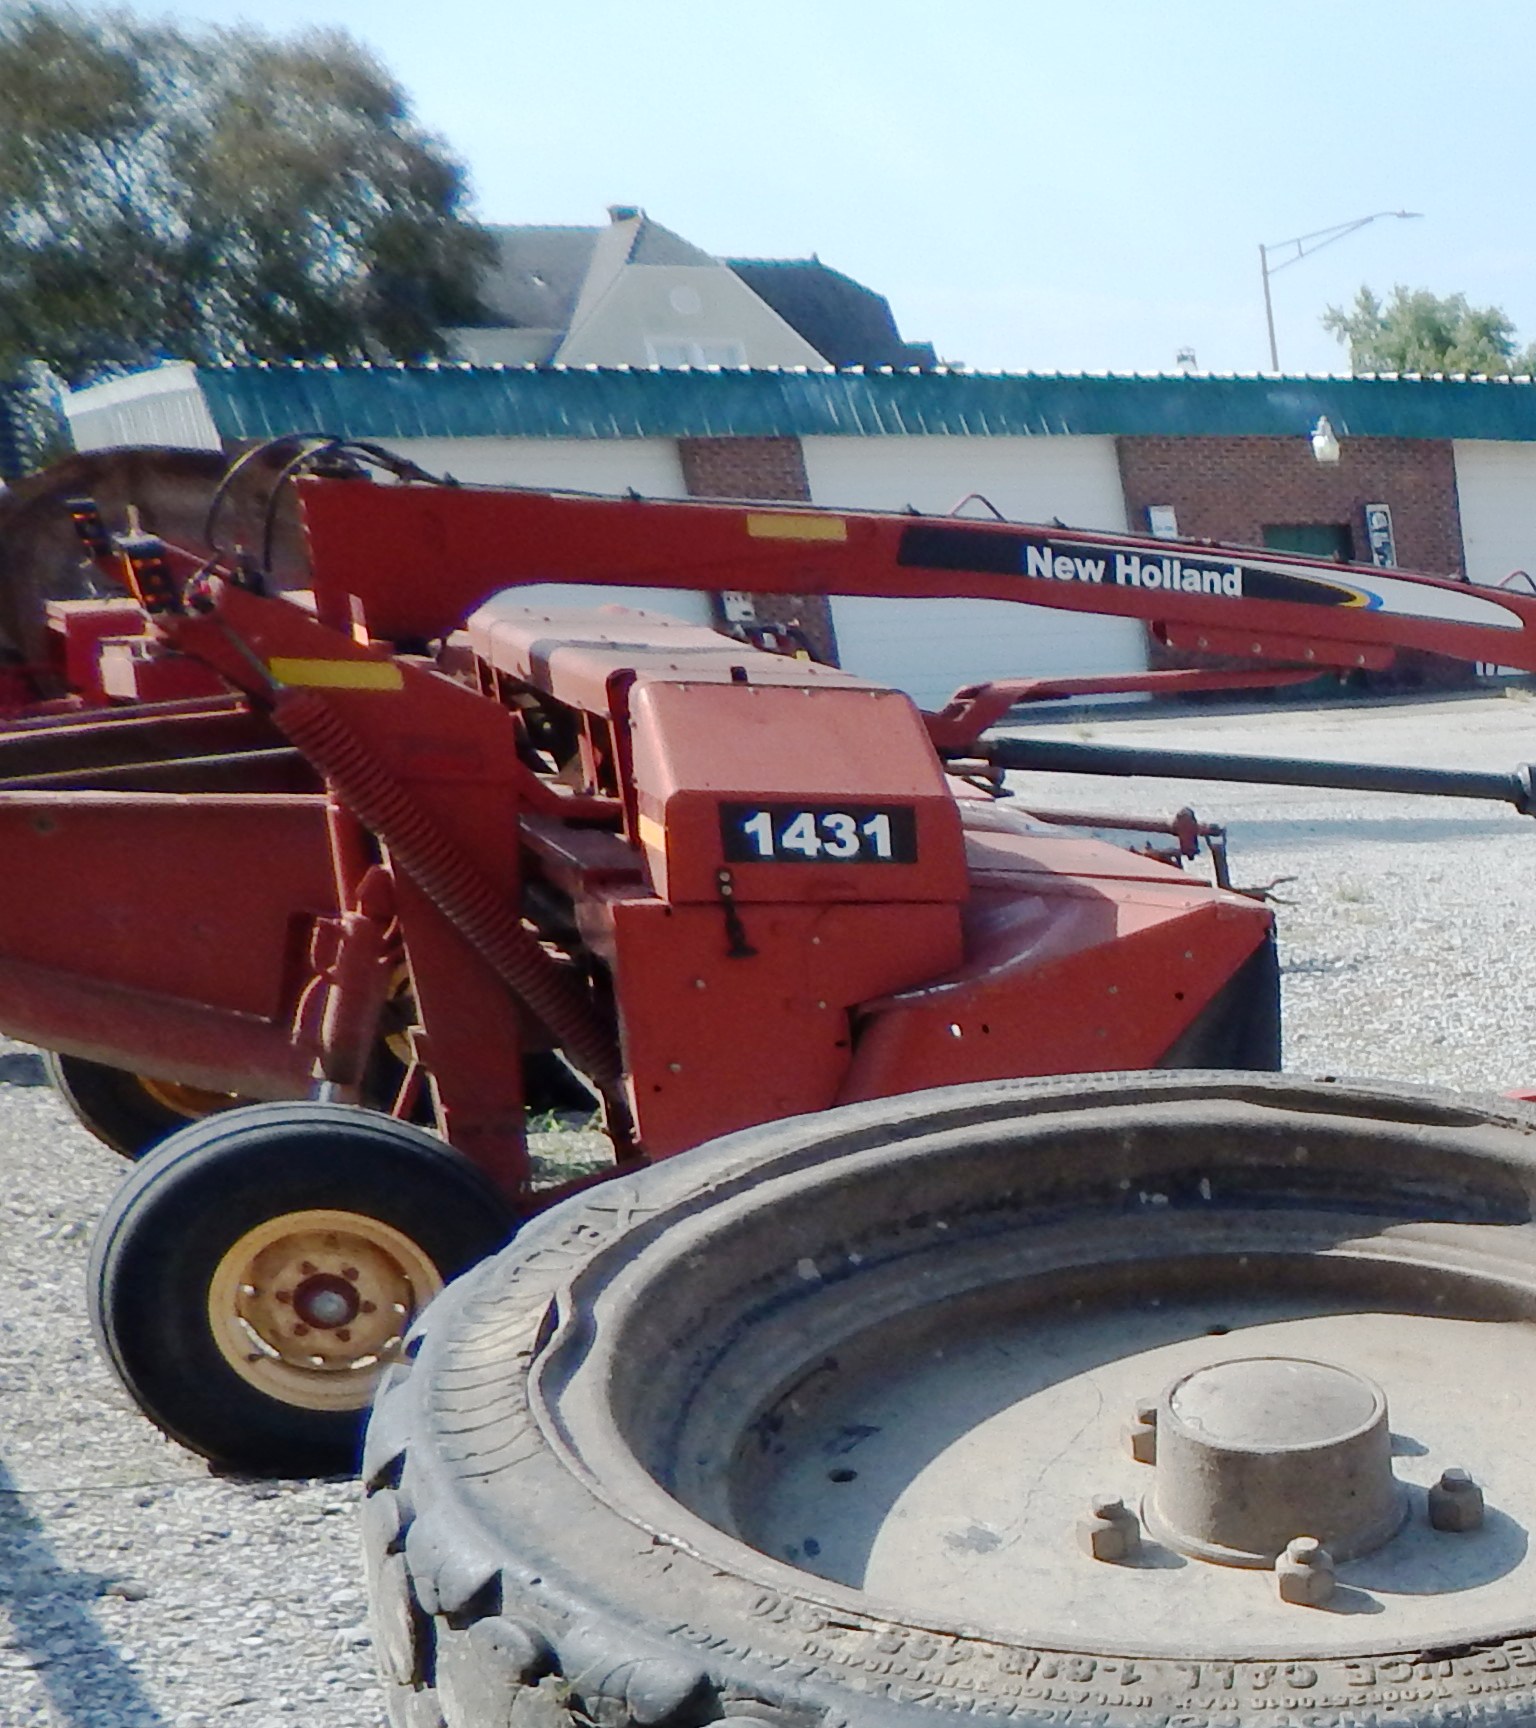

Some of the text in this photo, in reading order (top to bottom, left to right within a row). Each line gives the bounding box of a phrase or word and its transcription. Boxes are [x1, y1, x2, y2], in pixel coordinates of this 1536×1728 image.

[1026, 545, 1243, 598] New Holland
[744, 811, 892, 858] 1431
[1174, 1663, 1319, 1692] CALL
